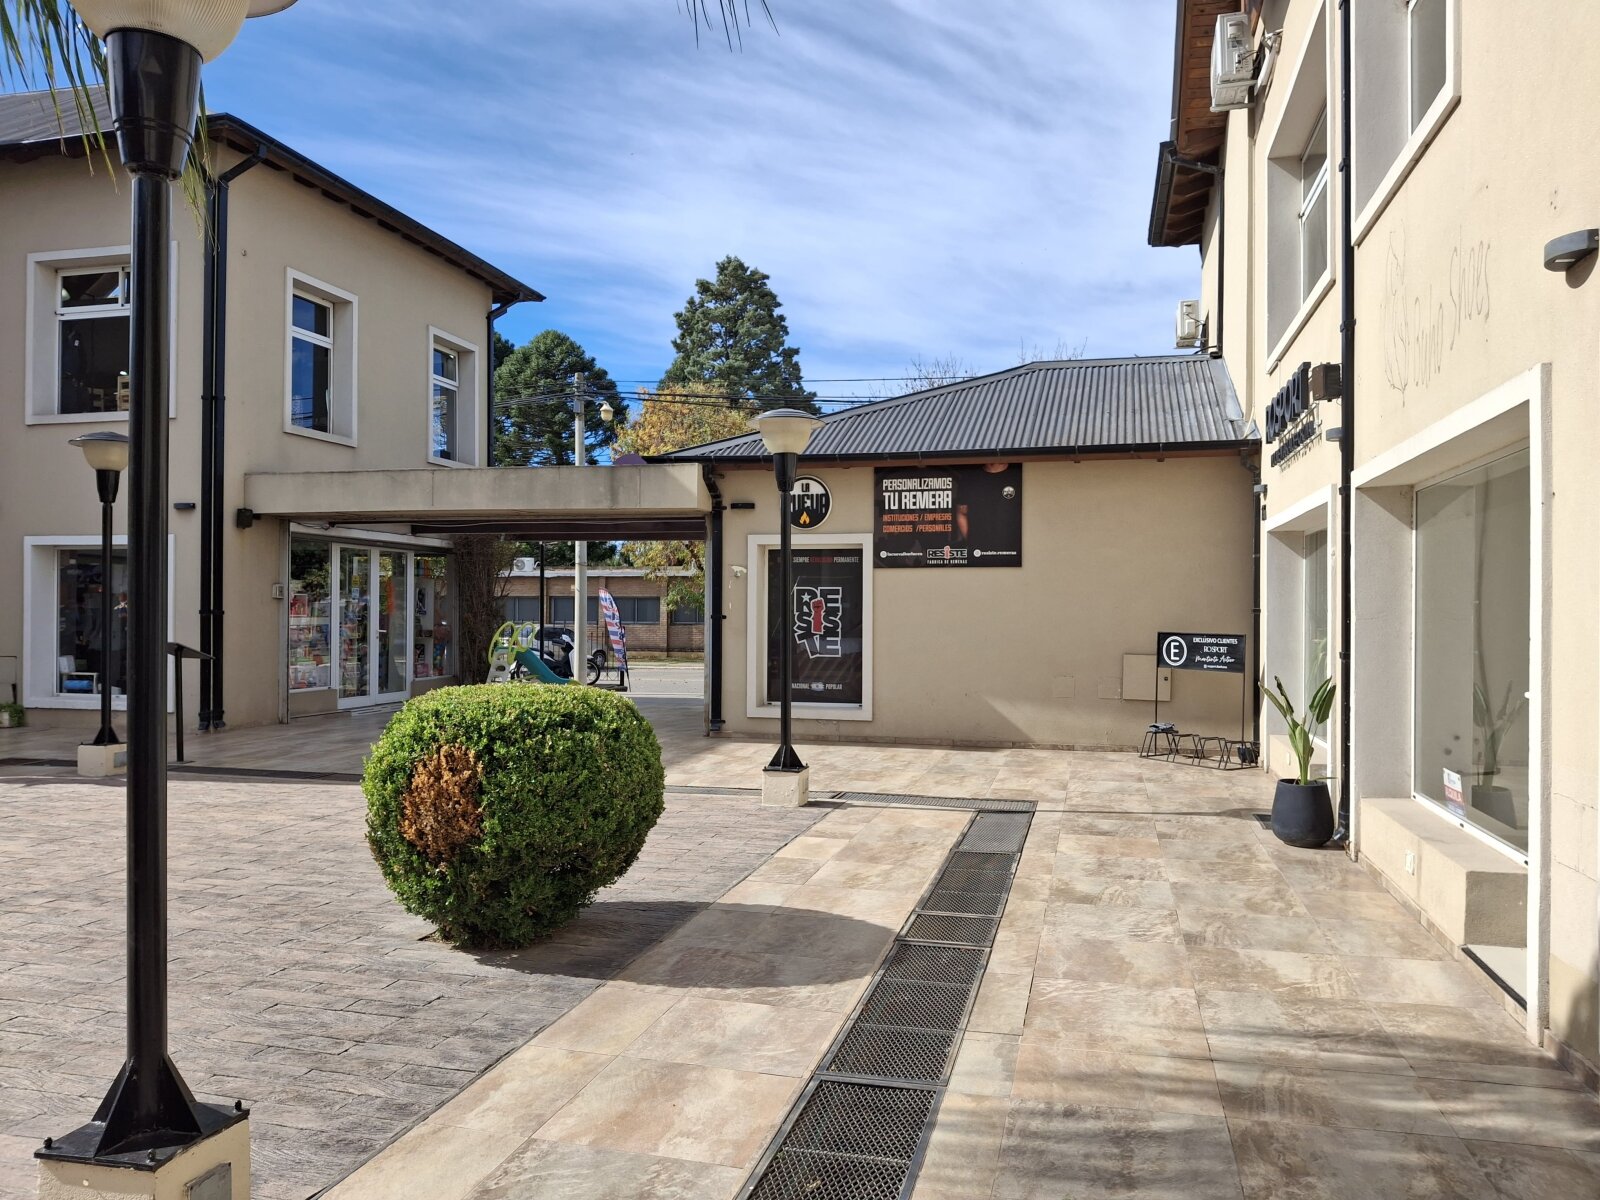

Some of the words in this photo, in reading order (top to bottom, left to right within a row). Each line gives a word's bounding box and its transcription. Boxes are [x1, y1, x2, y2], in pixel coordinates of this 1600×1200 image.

[802, 483, 810, 492] LA
[882, 478, 952, 490] PERSONALIZAMOS
[883, 492, 899, 510] TU
[901, 490, 952, 509] REMERA
[882, 514, 919, 522] INSTITUCIONES
[924, 513, 952, 521] EMPRESAS
[882, 524, 913, 533] COMERCIOS
[1170, 642, 1180, 660] E
[791, 682, 810, 690] NACIONAL
